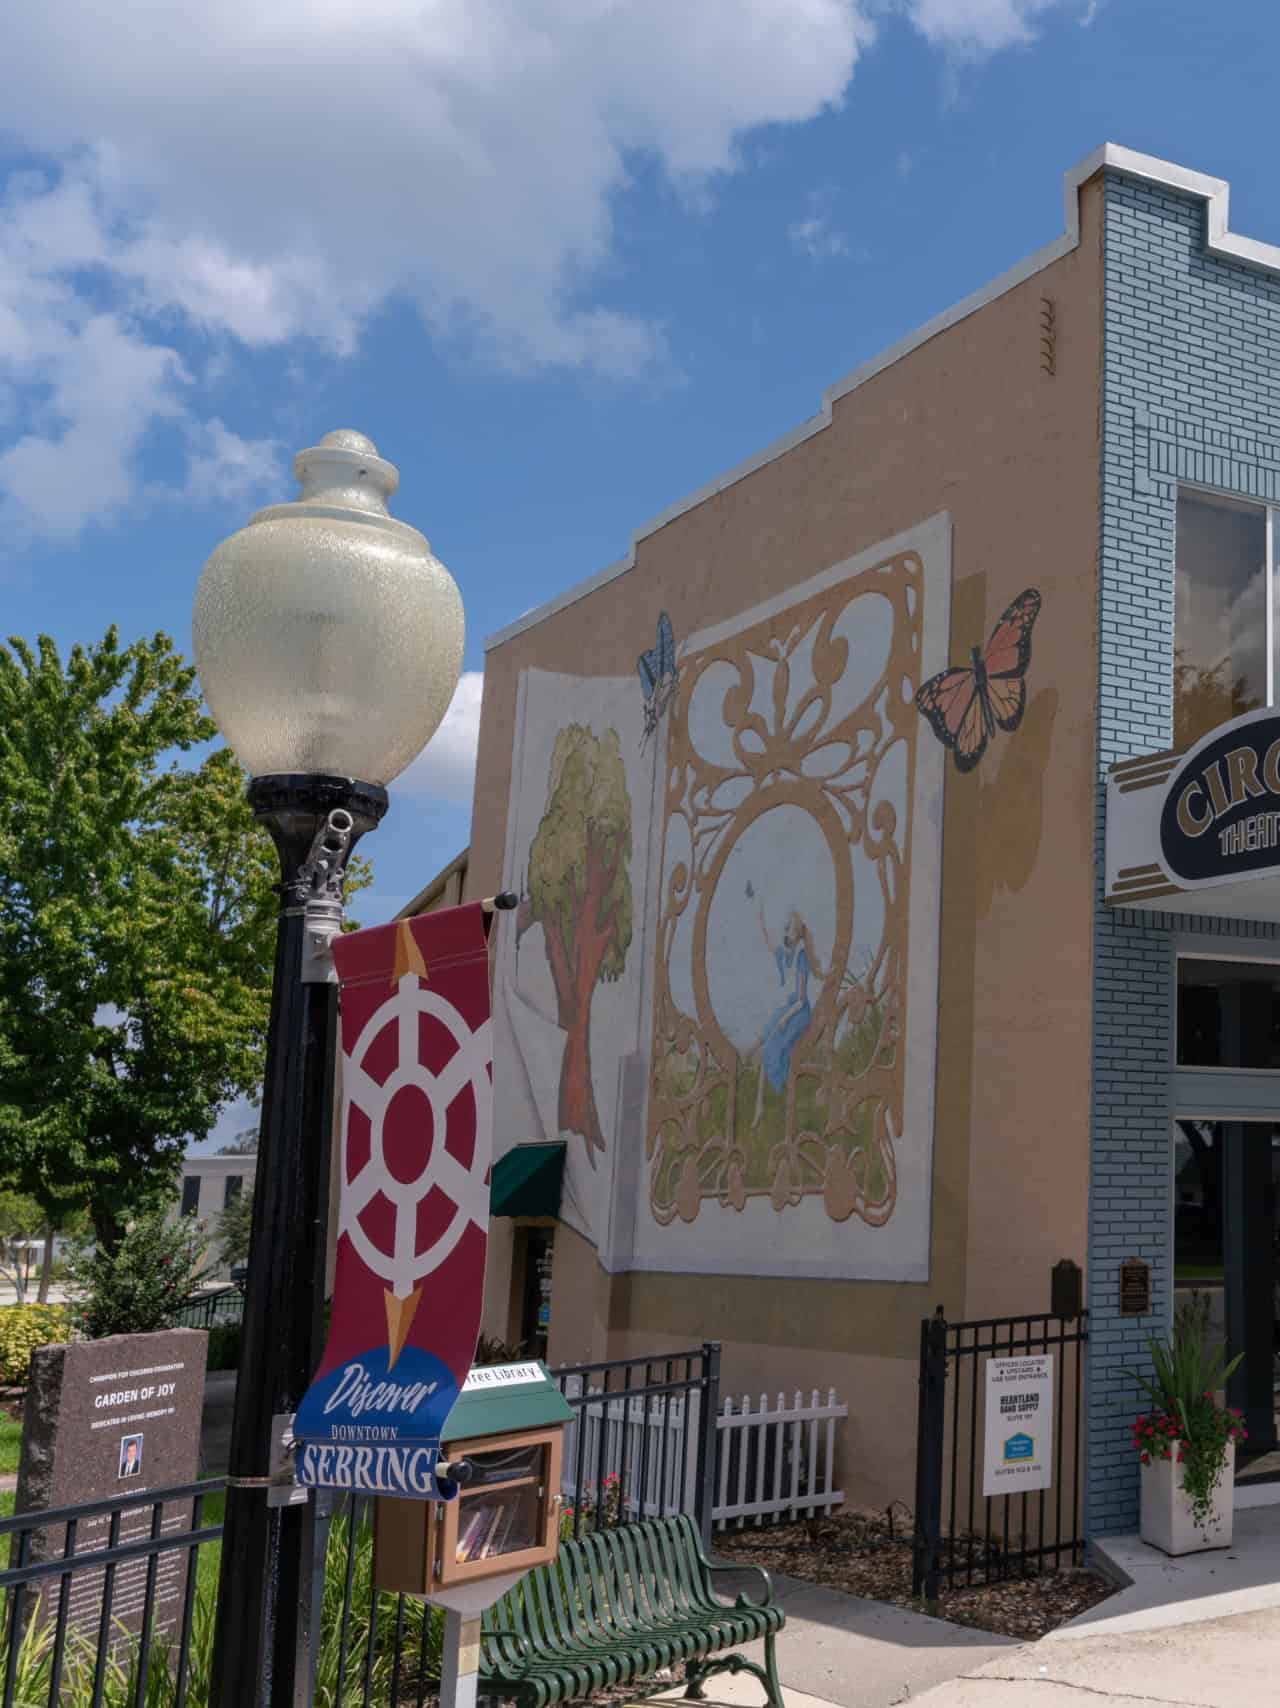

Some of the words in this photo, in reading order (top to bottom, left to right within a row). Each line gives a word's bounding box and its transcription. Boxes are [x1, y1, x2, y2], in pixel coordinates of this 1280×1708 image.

[493, 1367, 537, 1380] Library
[95, 1389, 138, 1408] GARDEN
[140, 1385, 155, 1400] OF
[157, 1382, 176, 1398] JOY
[323, 1363, 438, 1418] Discover
[331, 1424, 399, 1441] DOWNTOWN
[302, 1444, 433, 1494] SEBRING
